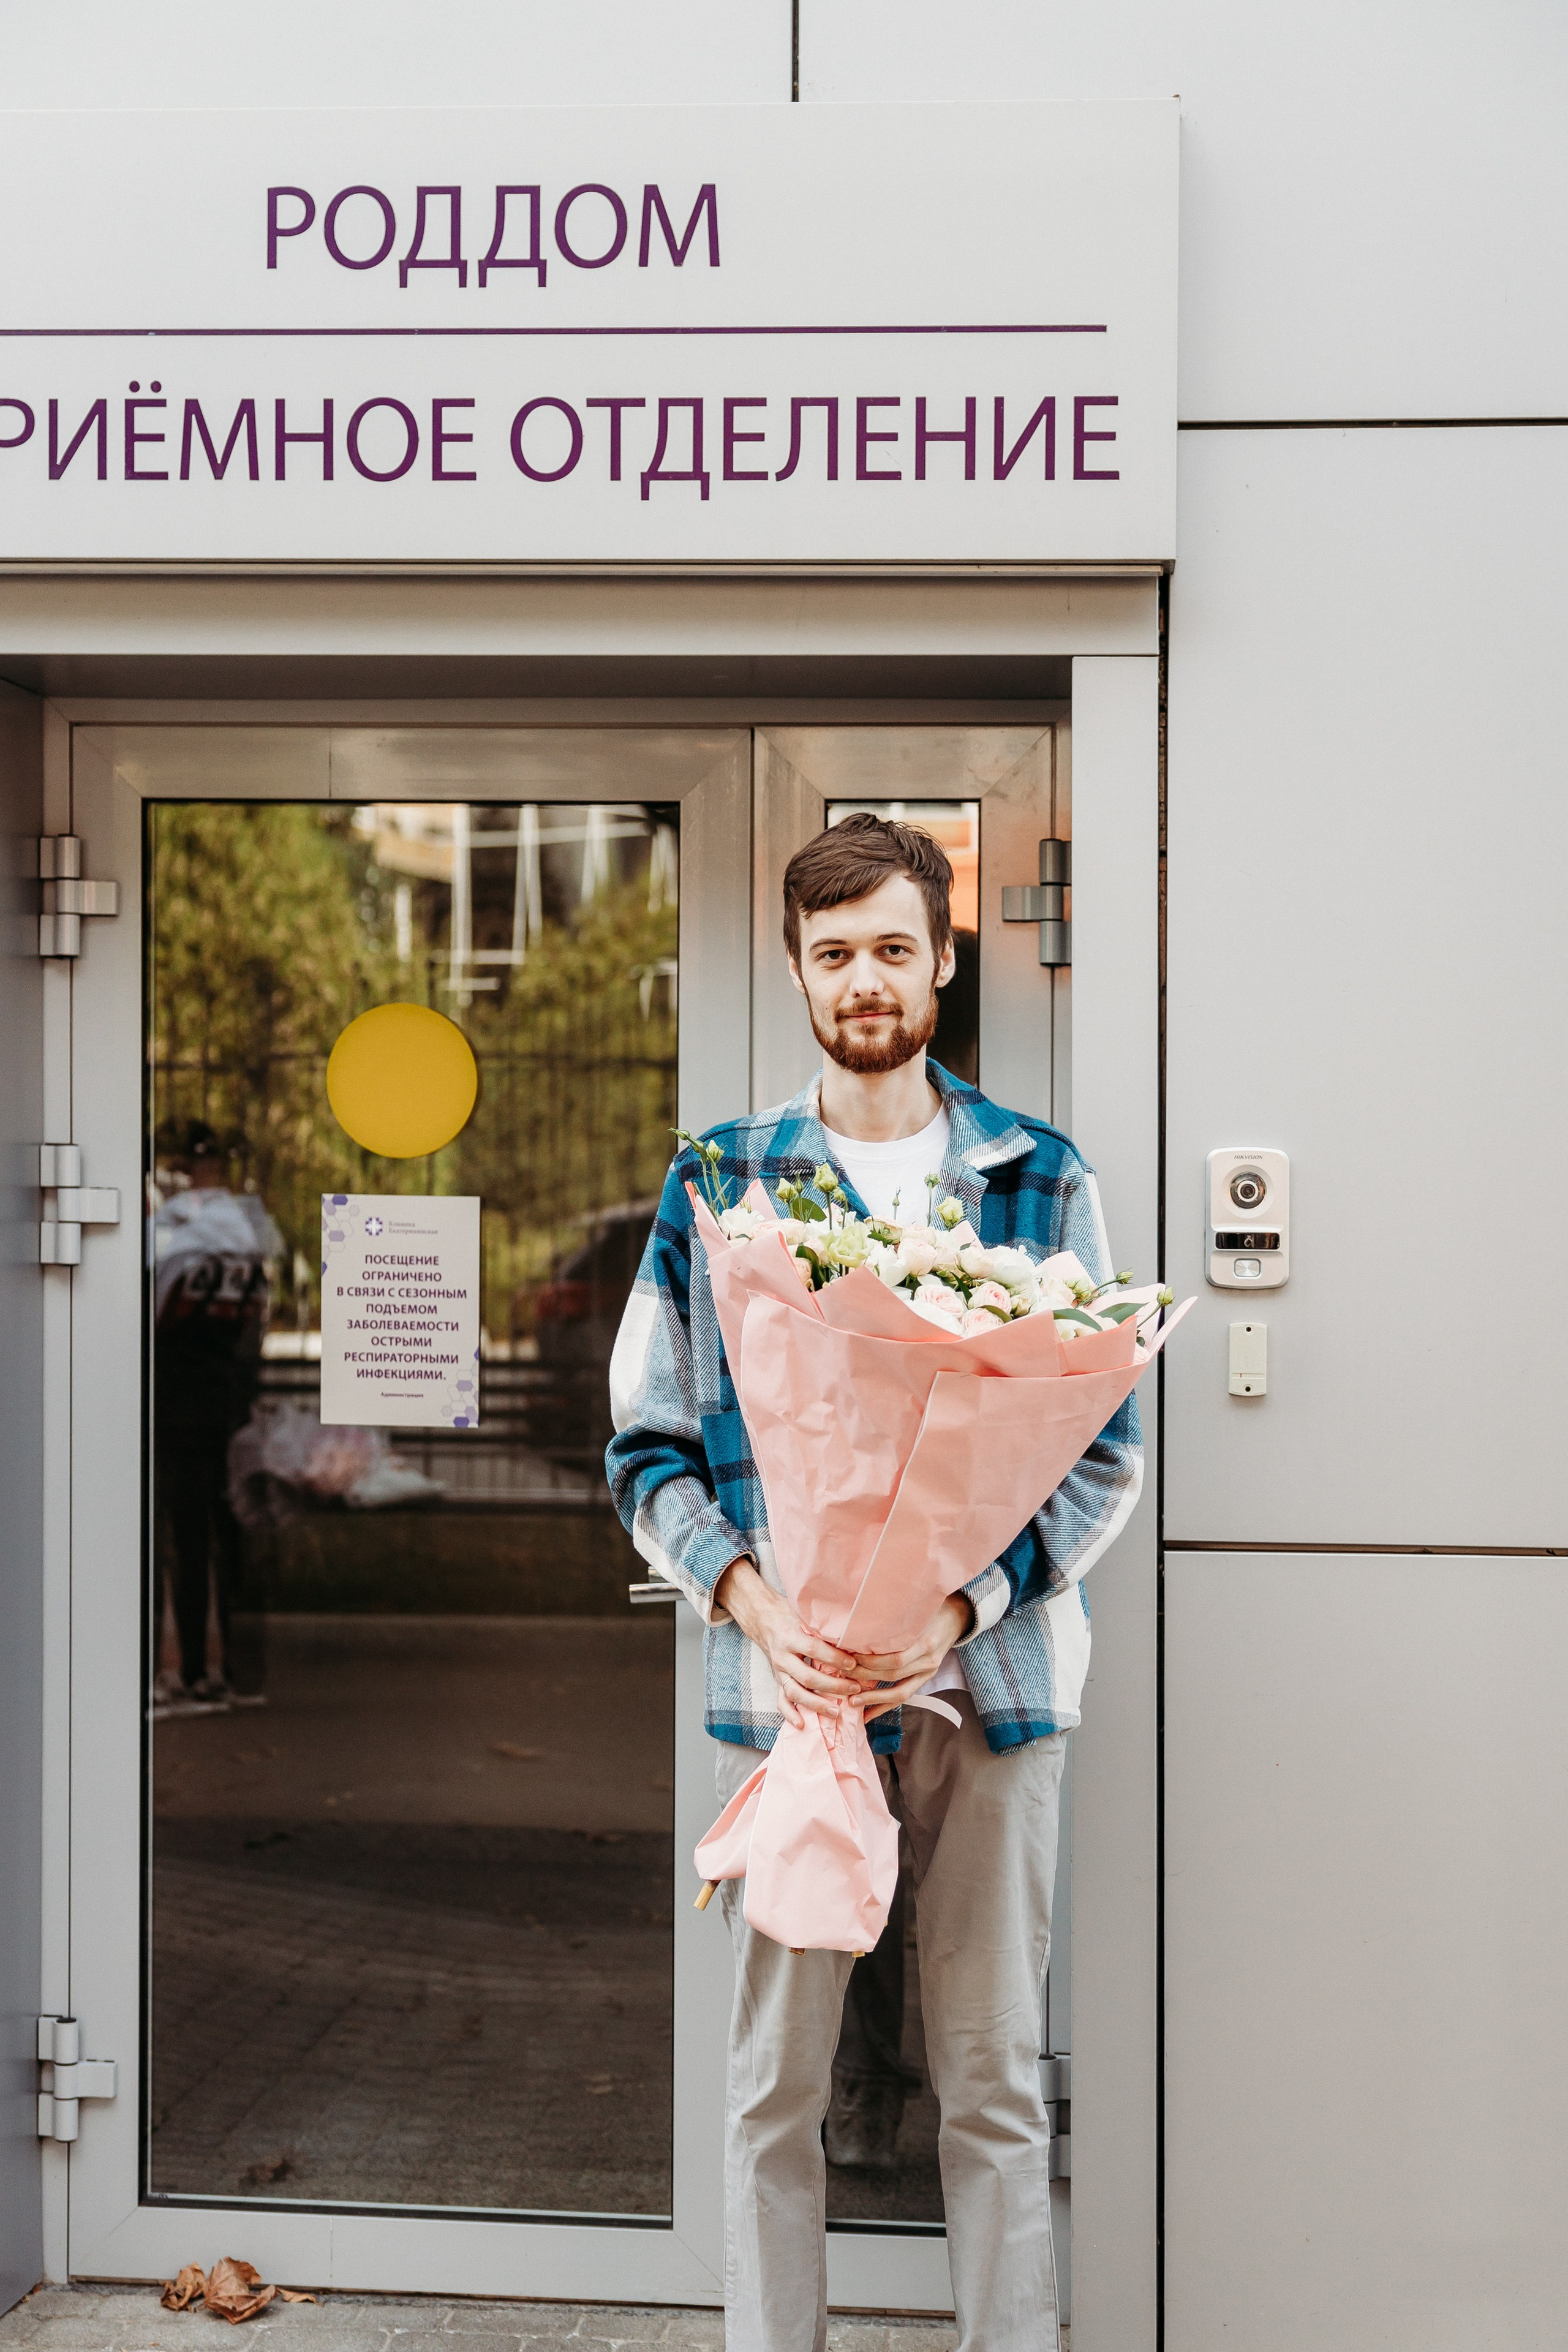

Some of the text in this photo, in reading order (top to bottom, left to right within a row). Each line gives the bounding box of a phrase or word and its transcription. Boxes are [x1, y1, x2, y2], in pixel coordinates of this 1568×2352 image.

[266, 183, 720, 288] РОДДОМ
[510, 396, 1120, 501] ОТДЕЛЕНИЕ
[365, 1254, 439, 1267] ПОСЕЩЕНИЕ
[362, 1271, 442, 1282] ОГРАНИЧЕНО
[337, 1286, 467, 1299] В СВЯЗИ С СЕЗОННЫМ
[366, 1303, 437, 1316] ПОДЪЕМОМ
[347, 1319, 459, 1331] ЗАБОЛЕВАЕМОСТИ
[371, 1336, 432, 1347] ОСТРЫМИ
[344, 1352, 459, 1364] РЕСПИРАТОРНЫМИ
[356, 1368, 446, 1381] ИНФЕКЦИЯМИ.
